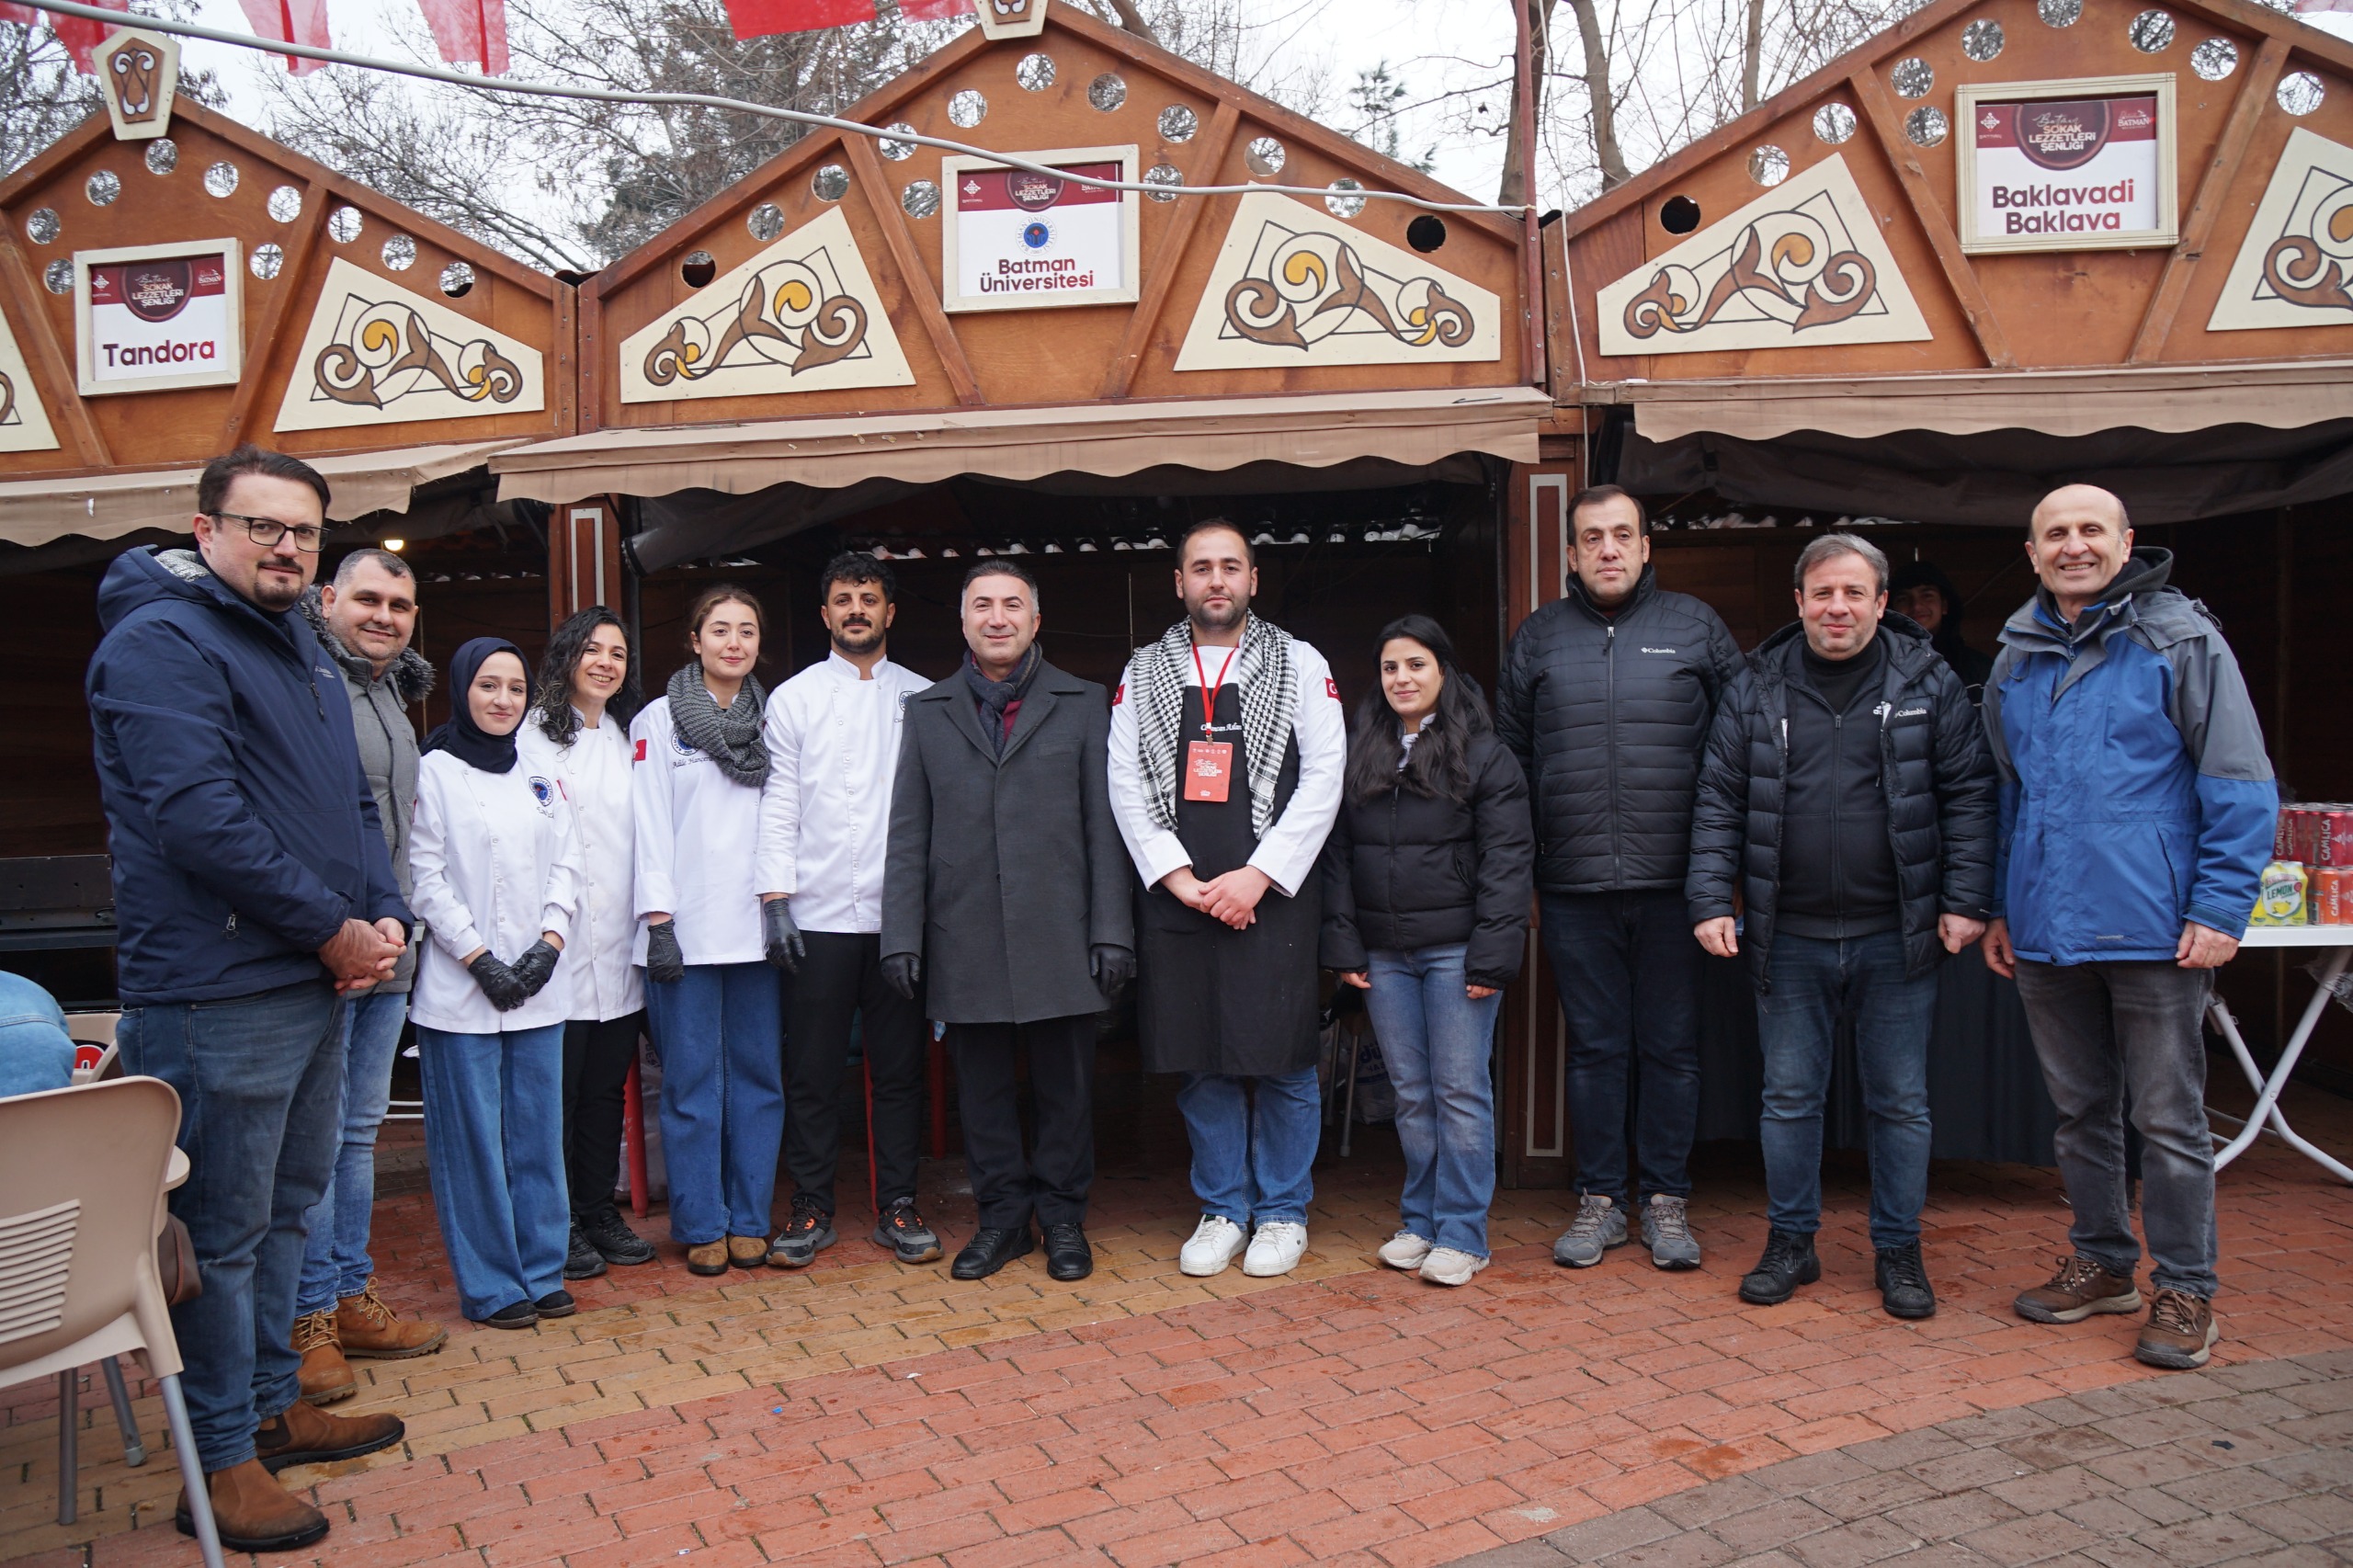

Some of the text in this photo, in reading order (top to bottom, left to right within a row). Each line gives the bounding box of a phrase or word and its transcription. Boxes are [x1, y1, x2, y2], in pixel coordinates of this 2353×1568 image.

[2043, 124, 2082, 134] SOKAK
[2118, 117, 2149, 127] BATMAN
[1993, 178, 2134, 209] Baklavadi
[2006, 210, 2120, 234] Baklava
[999, 258, 1075, 275] Batman
[980, 270, 1094, 293] Üniversitesi
[103, 339, 215, 368] Tandora
[1898, 708, 1927, 717] Columbia
[2267, 883, 2293, 901] LEMON
